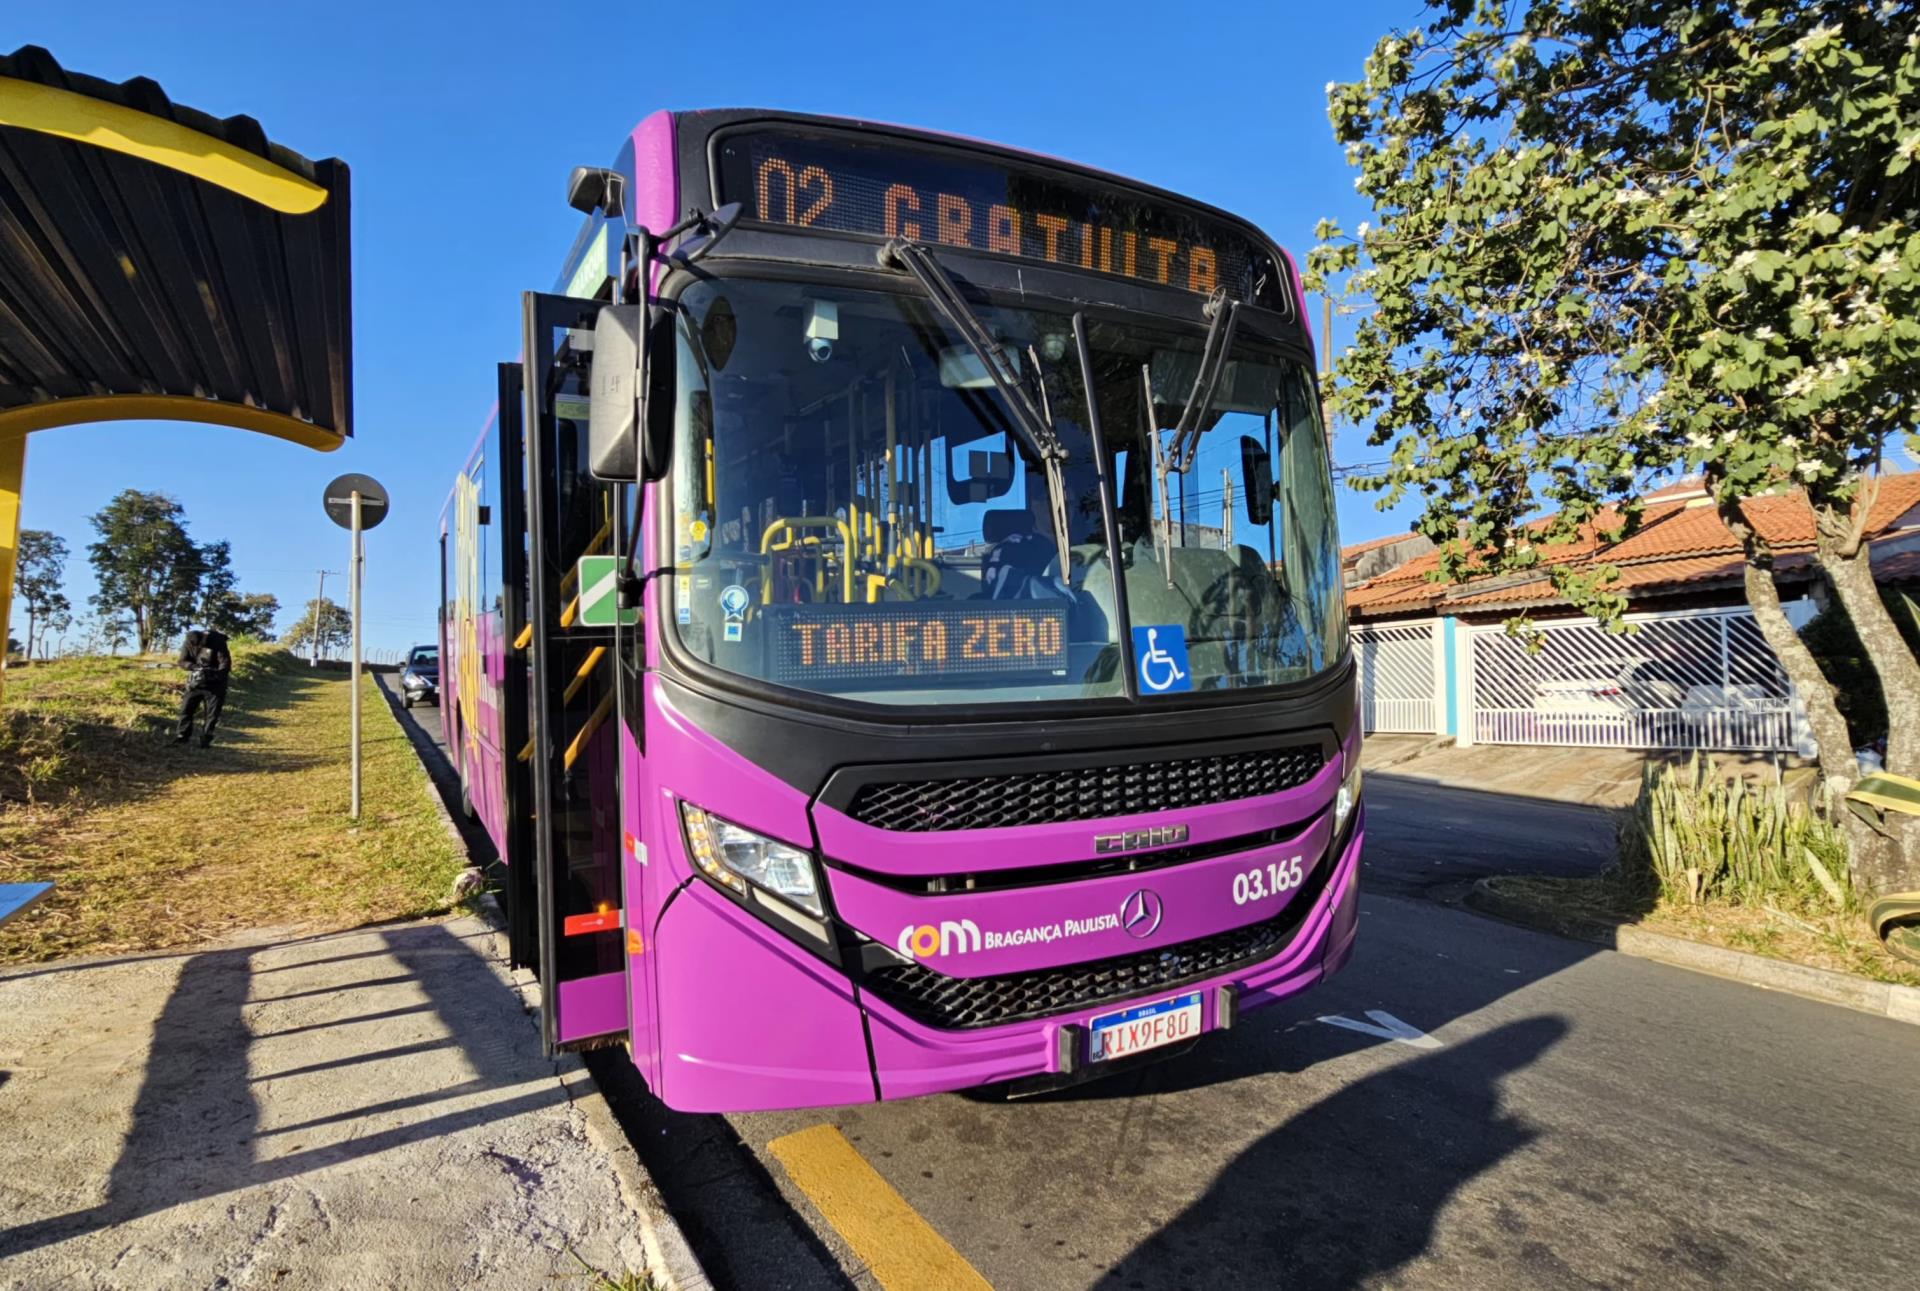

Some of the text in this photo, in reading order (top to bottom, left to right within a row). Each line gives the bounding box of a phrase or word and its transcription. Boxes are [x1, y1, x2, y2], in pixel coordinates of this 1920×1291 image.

[791, 616, 1060, 666] TARIFA ZERO
[1232, 855, 1303, 906] 03.165
[984, 924, 1063, 950] BRAGANÇA
[1064, 913, 1120, 938] PAULISTA
[1101, 1011, 1189, 1056] RIX9F80
